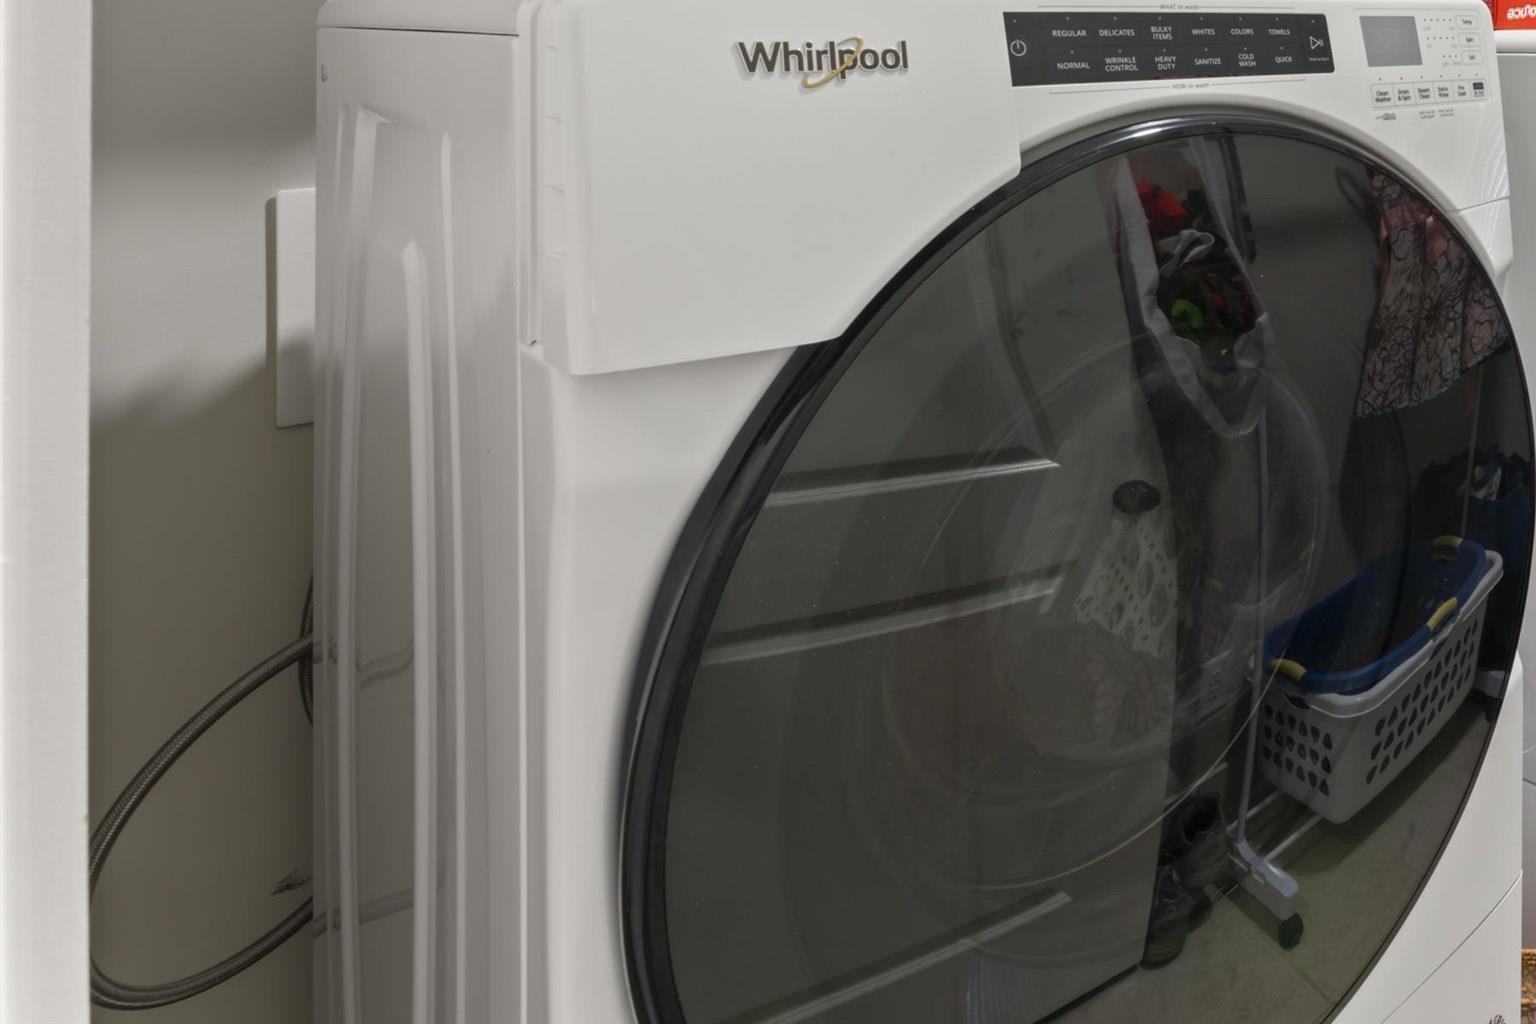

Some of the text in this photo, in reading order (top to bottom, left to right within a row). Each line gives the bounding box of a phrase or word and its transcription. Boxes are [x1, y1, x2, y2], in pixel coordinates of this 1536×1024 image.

[1052, 29, 1087, 37] REGULAR
[1098, 29, 1135, 37] DELICATES
[738, 39, 909, 81] Whirlpool
[1105, 56, 1137, 64] WRINKLE
[1194, 57, 1222, 65] SANITIZE
[1057, 62, 1090, 70] NORMAL
[1105, 64, 1139, 72] CONTROL
